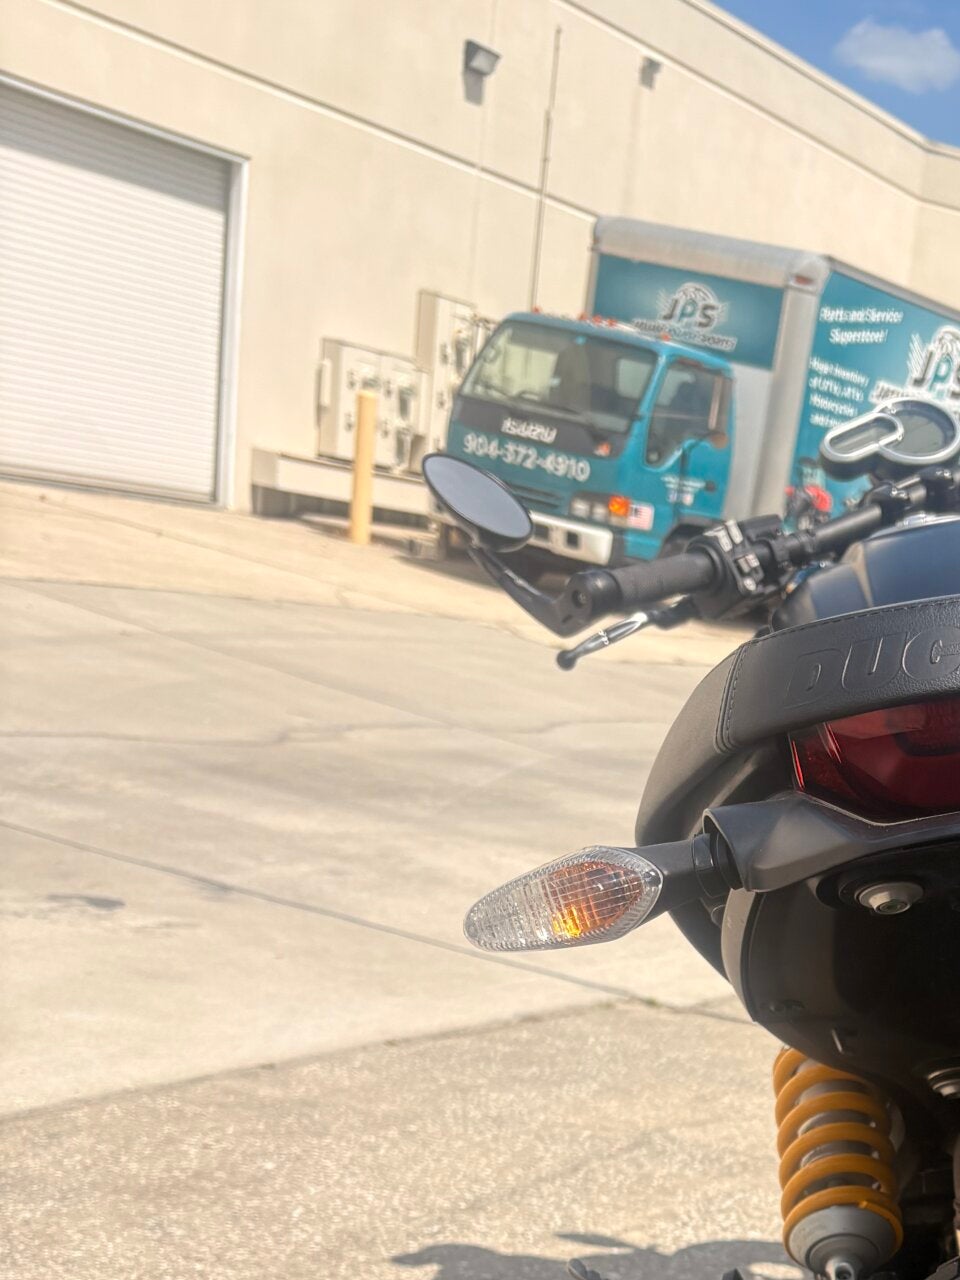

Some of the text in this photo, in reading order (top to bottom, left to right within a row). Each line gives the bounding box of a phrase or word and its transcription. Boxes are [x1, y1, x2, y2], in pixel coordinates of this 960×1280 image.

[662, 298, 719, 328] JPS
[820, 307, 847, 322] Parts
[864, 308, 903, 323] Service
[501, 417, 557, 444] ISUZU
[462, 432, 591, 481] 904-372-4910
